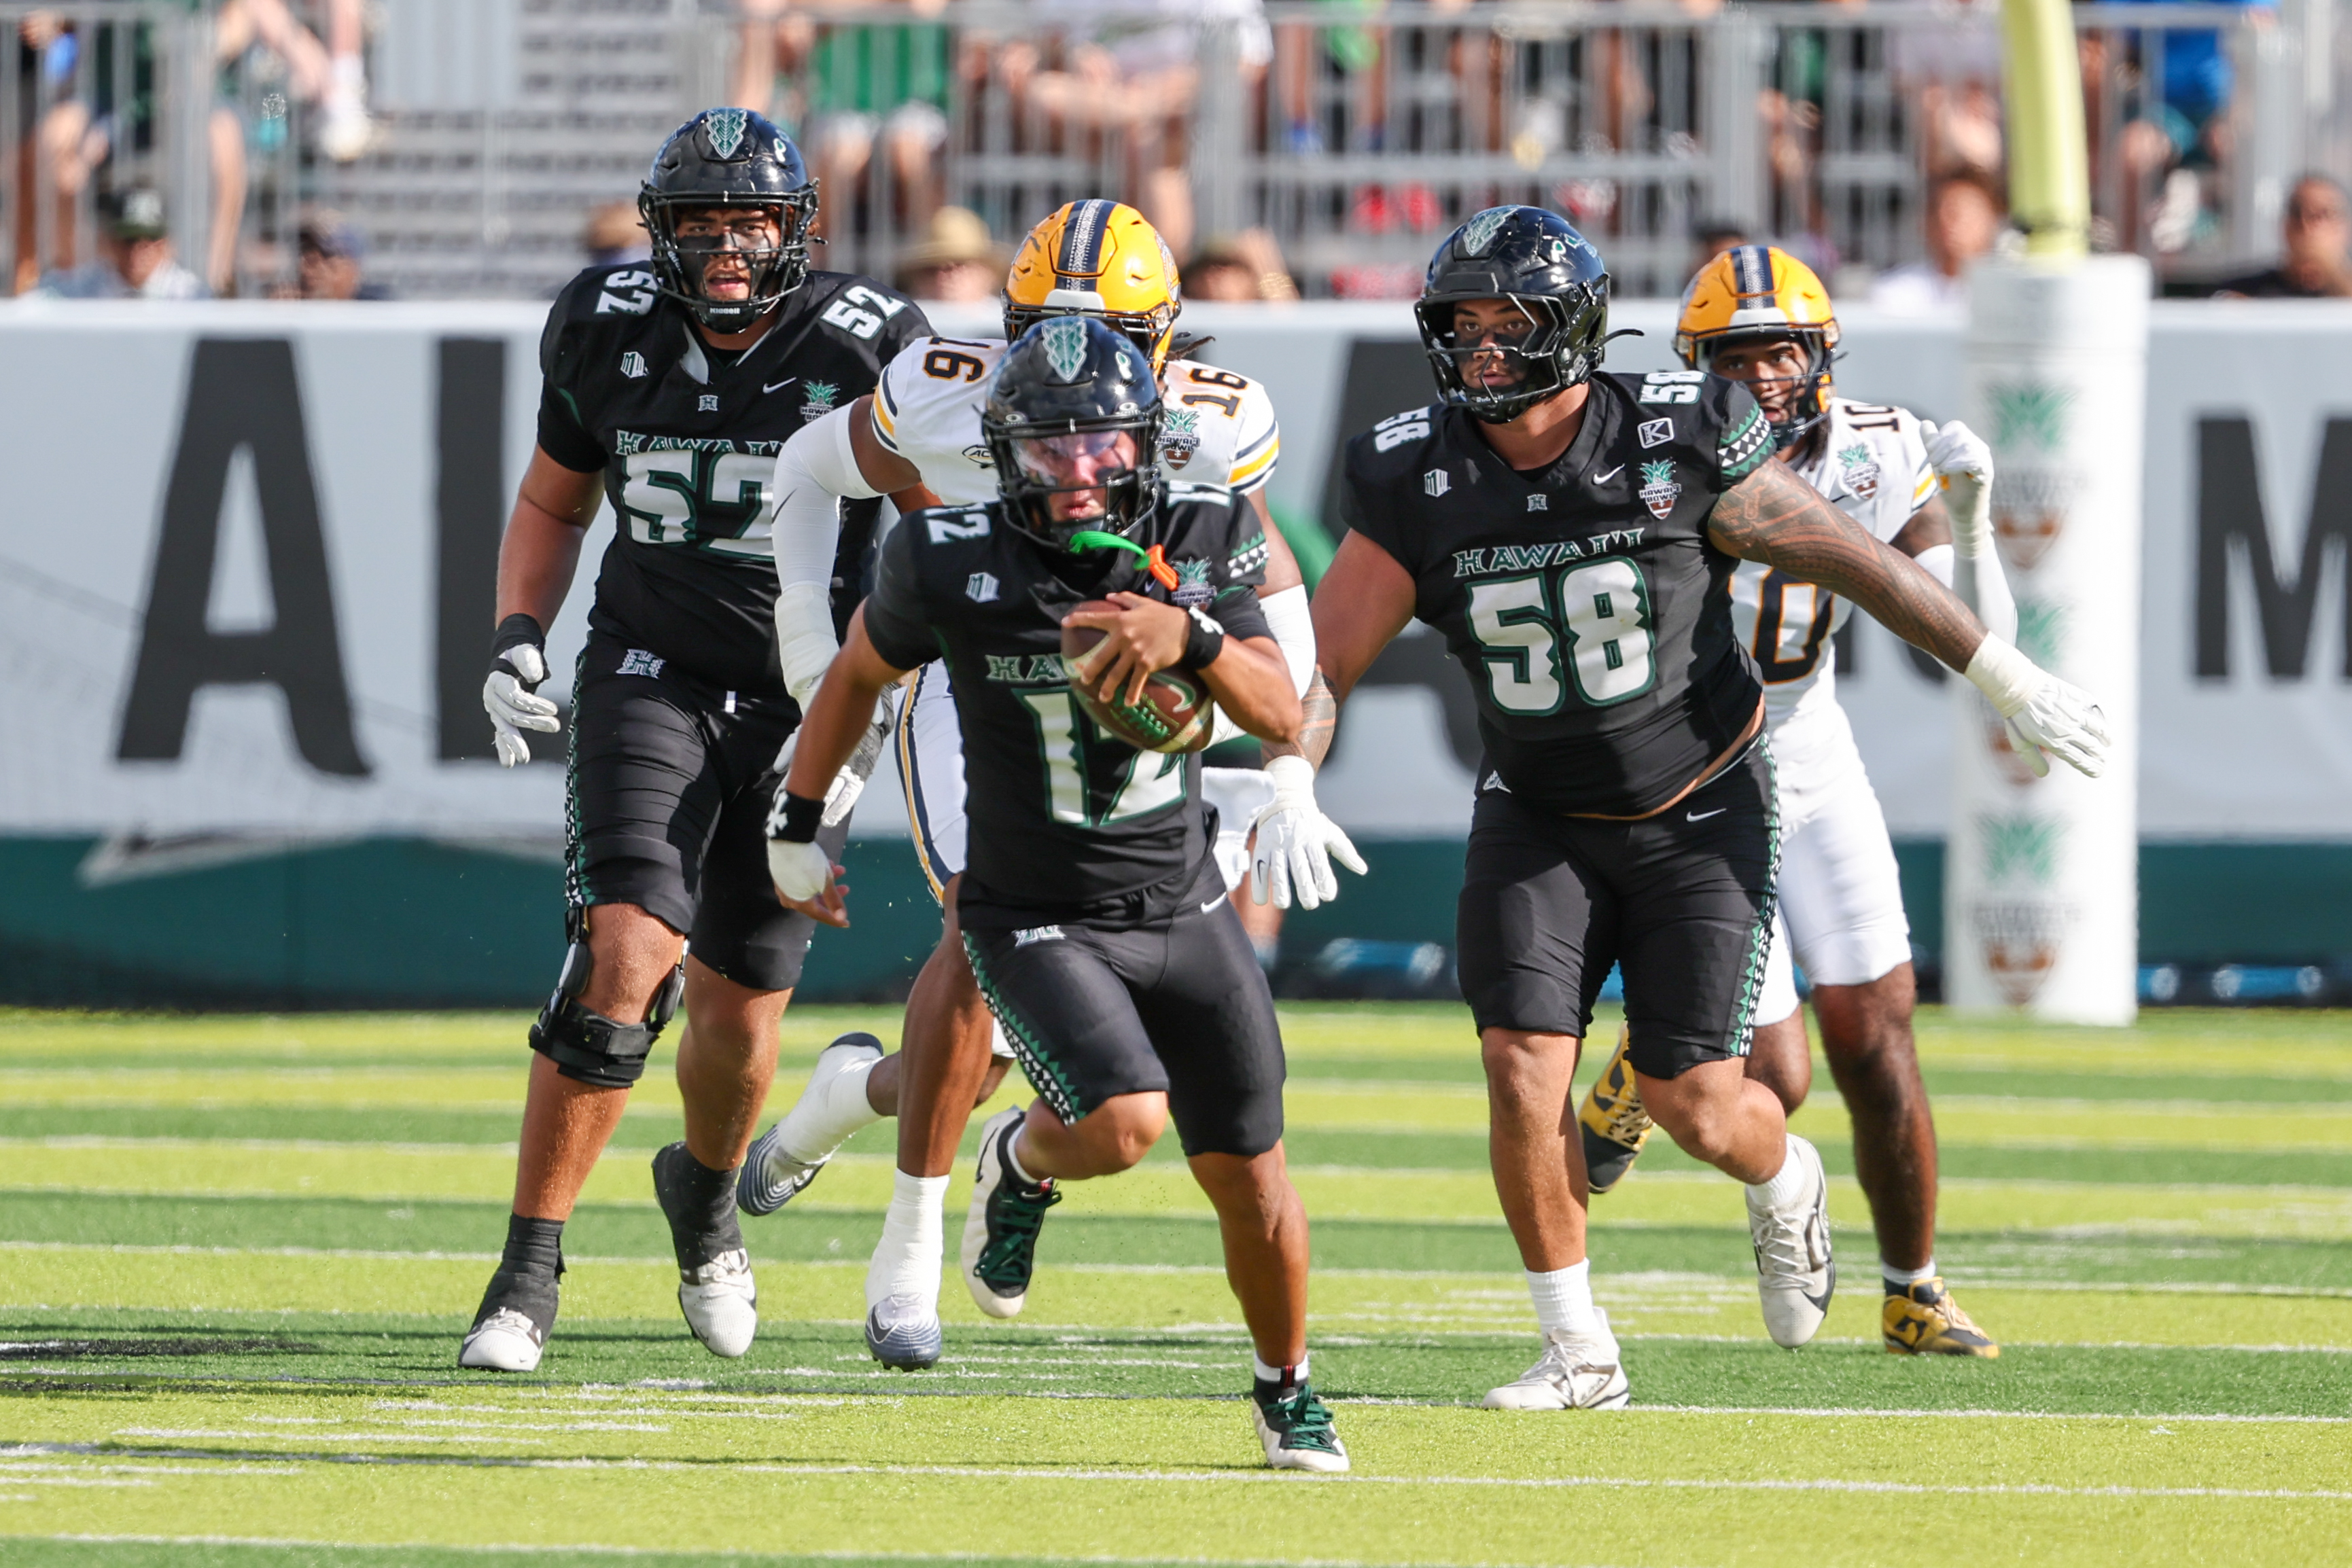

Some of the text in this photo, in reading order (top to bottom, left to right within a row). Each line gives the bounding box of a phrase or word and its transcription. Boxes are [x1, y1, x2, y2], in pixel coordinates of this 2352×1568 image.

[594, 270, 662, 317] 52
[820, 285, 909, 340] 52
[923, 336, 991, 384] 16
[1180, 367, 1250, 421] 16
[1638, 370, 1707, 404] 58
[1372, 406, 1433, 453] 58
[619, 447, 776, 563] 52
[924, 502, 991, 544] 12
[1464, 555, 1657, 717] 58
[1728, 566, 1835, 685] 0
